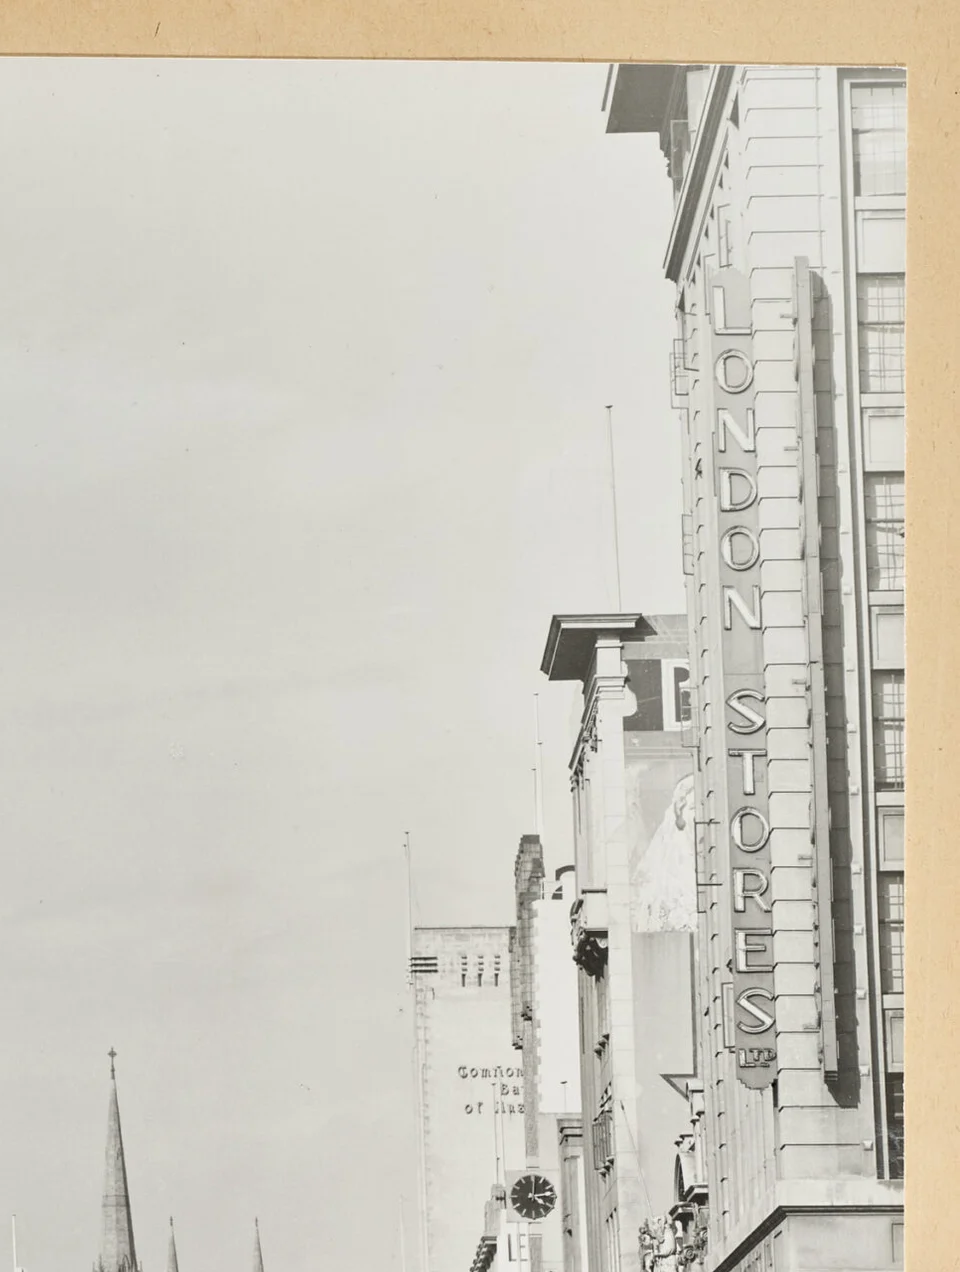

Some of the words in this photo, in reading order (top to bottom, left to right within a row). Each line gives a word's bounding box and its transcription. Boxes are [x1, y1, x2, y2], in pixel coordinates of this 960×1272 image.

[712, 286, 763, 632] LONDON
[726, 688, 777, 1035] STORES
[501, 1083, 524, 1096] Ba
[738, 1047, 777, 1068] LTD
